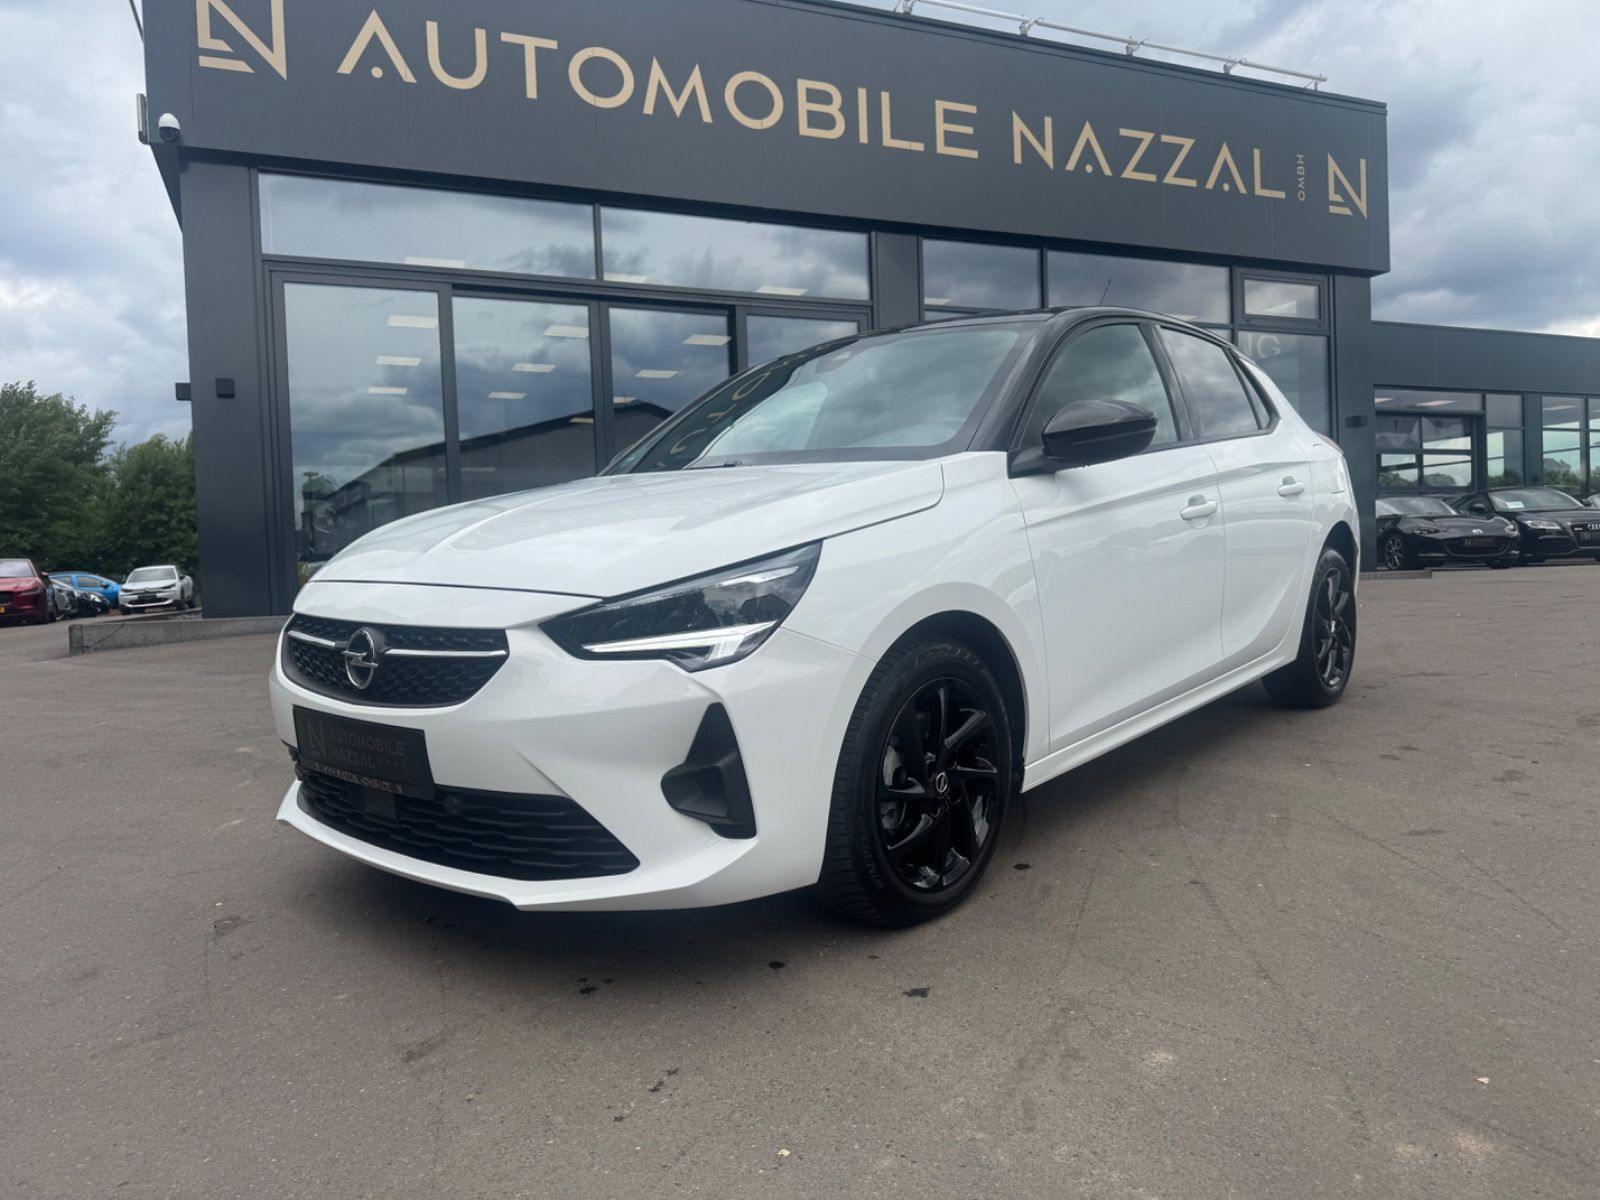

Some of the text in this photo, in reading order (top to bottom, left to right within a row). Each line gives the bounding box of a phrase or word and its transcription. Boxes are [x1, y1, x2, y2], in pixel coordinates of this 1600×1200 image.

[337, 9, 1286, 199] AUTOMOBILE NAZZAL
[329, 728, 406, 757] AUTOMOBILE
